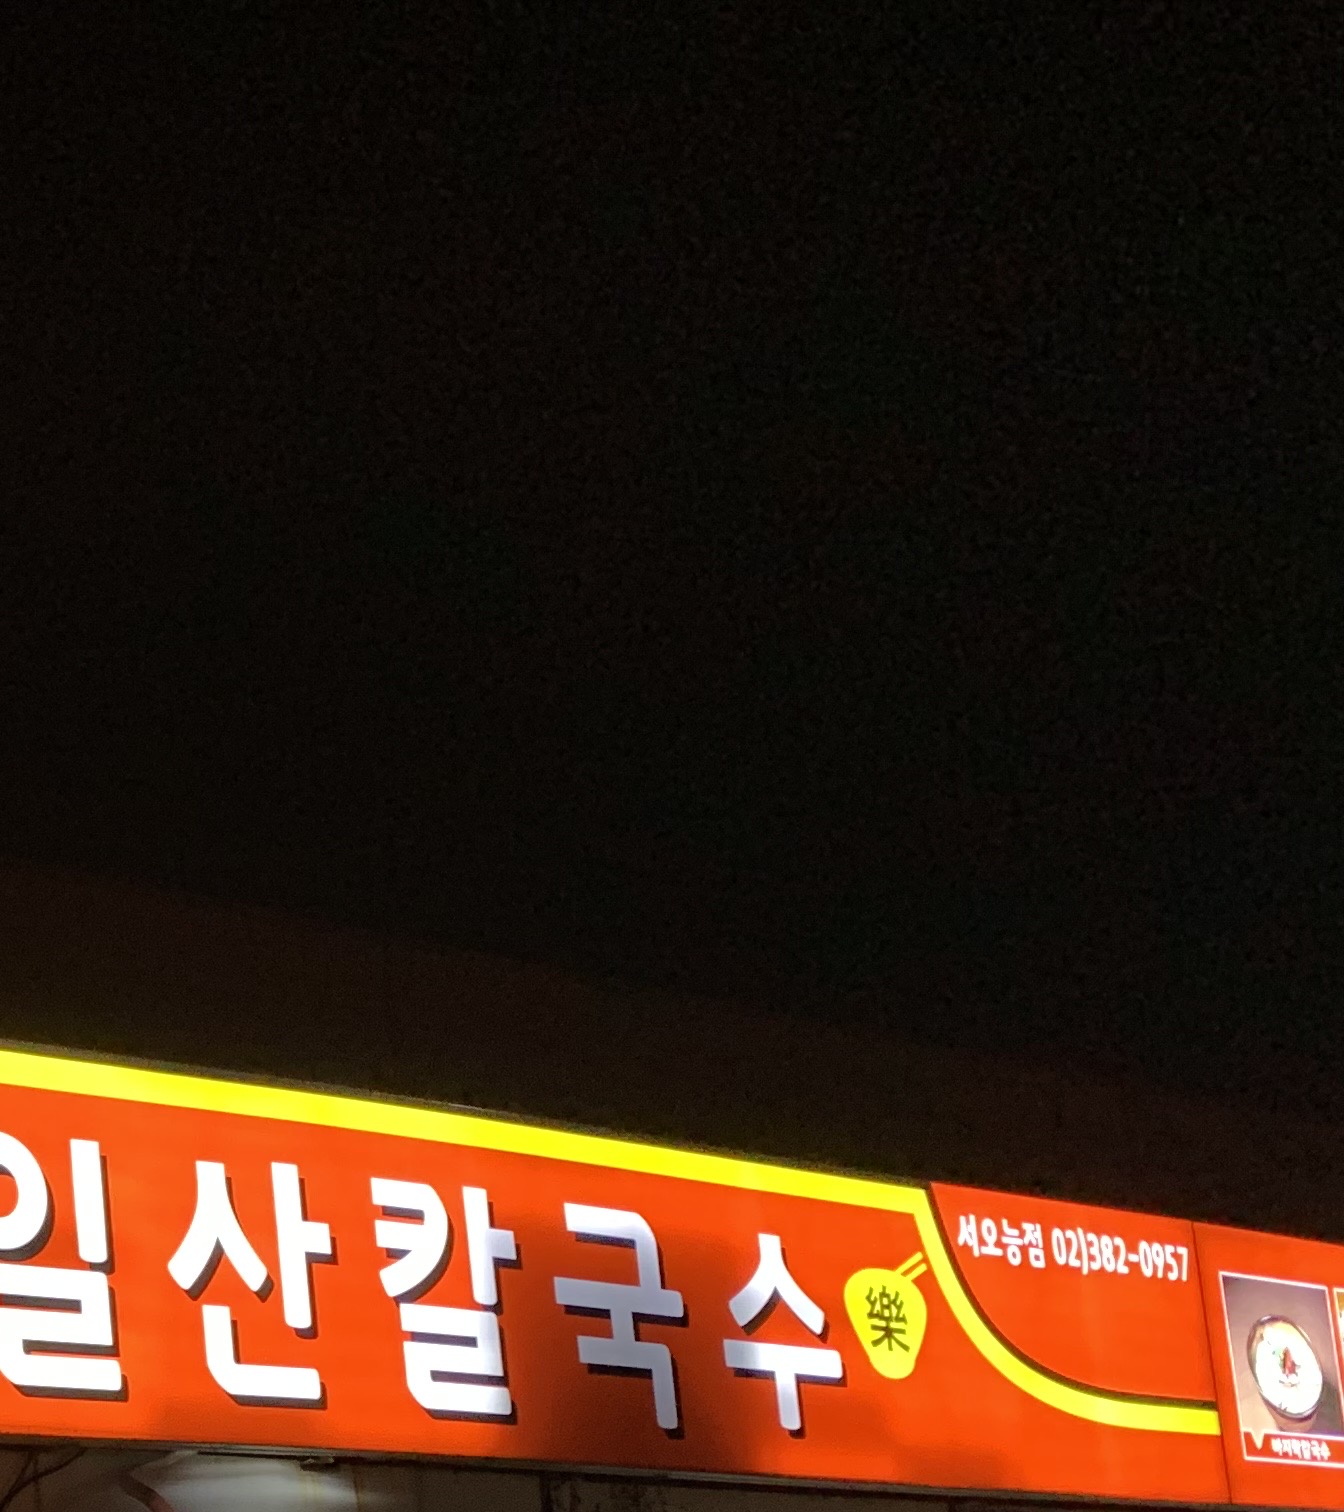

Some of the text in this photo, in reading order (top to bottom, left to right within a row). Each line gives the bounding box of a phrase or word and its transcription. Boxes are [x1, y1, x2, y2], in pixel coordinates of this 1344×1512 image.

[958, 1215, 1188, 1281] 서오능점 02)382-0957
[866, 1286, 910, 1352] 樂
